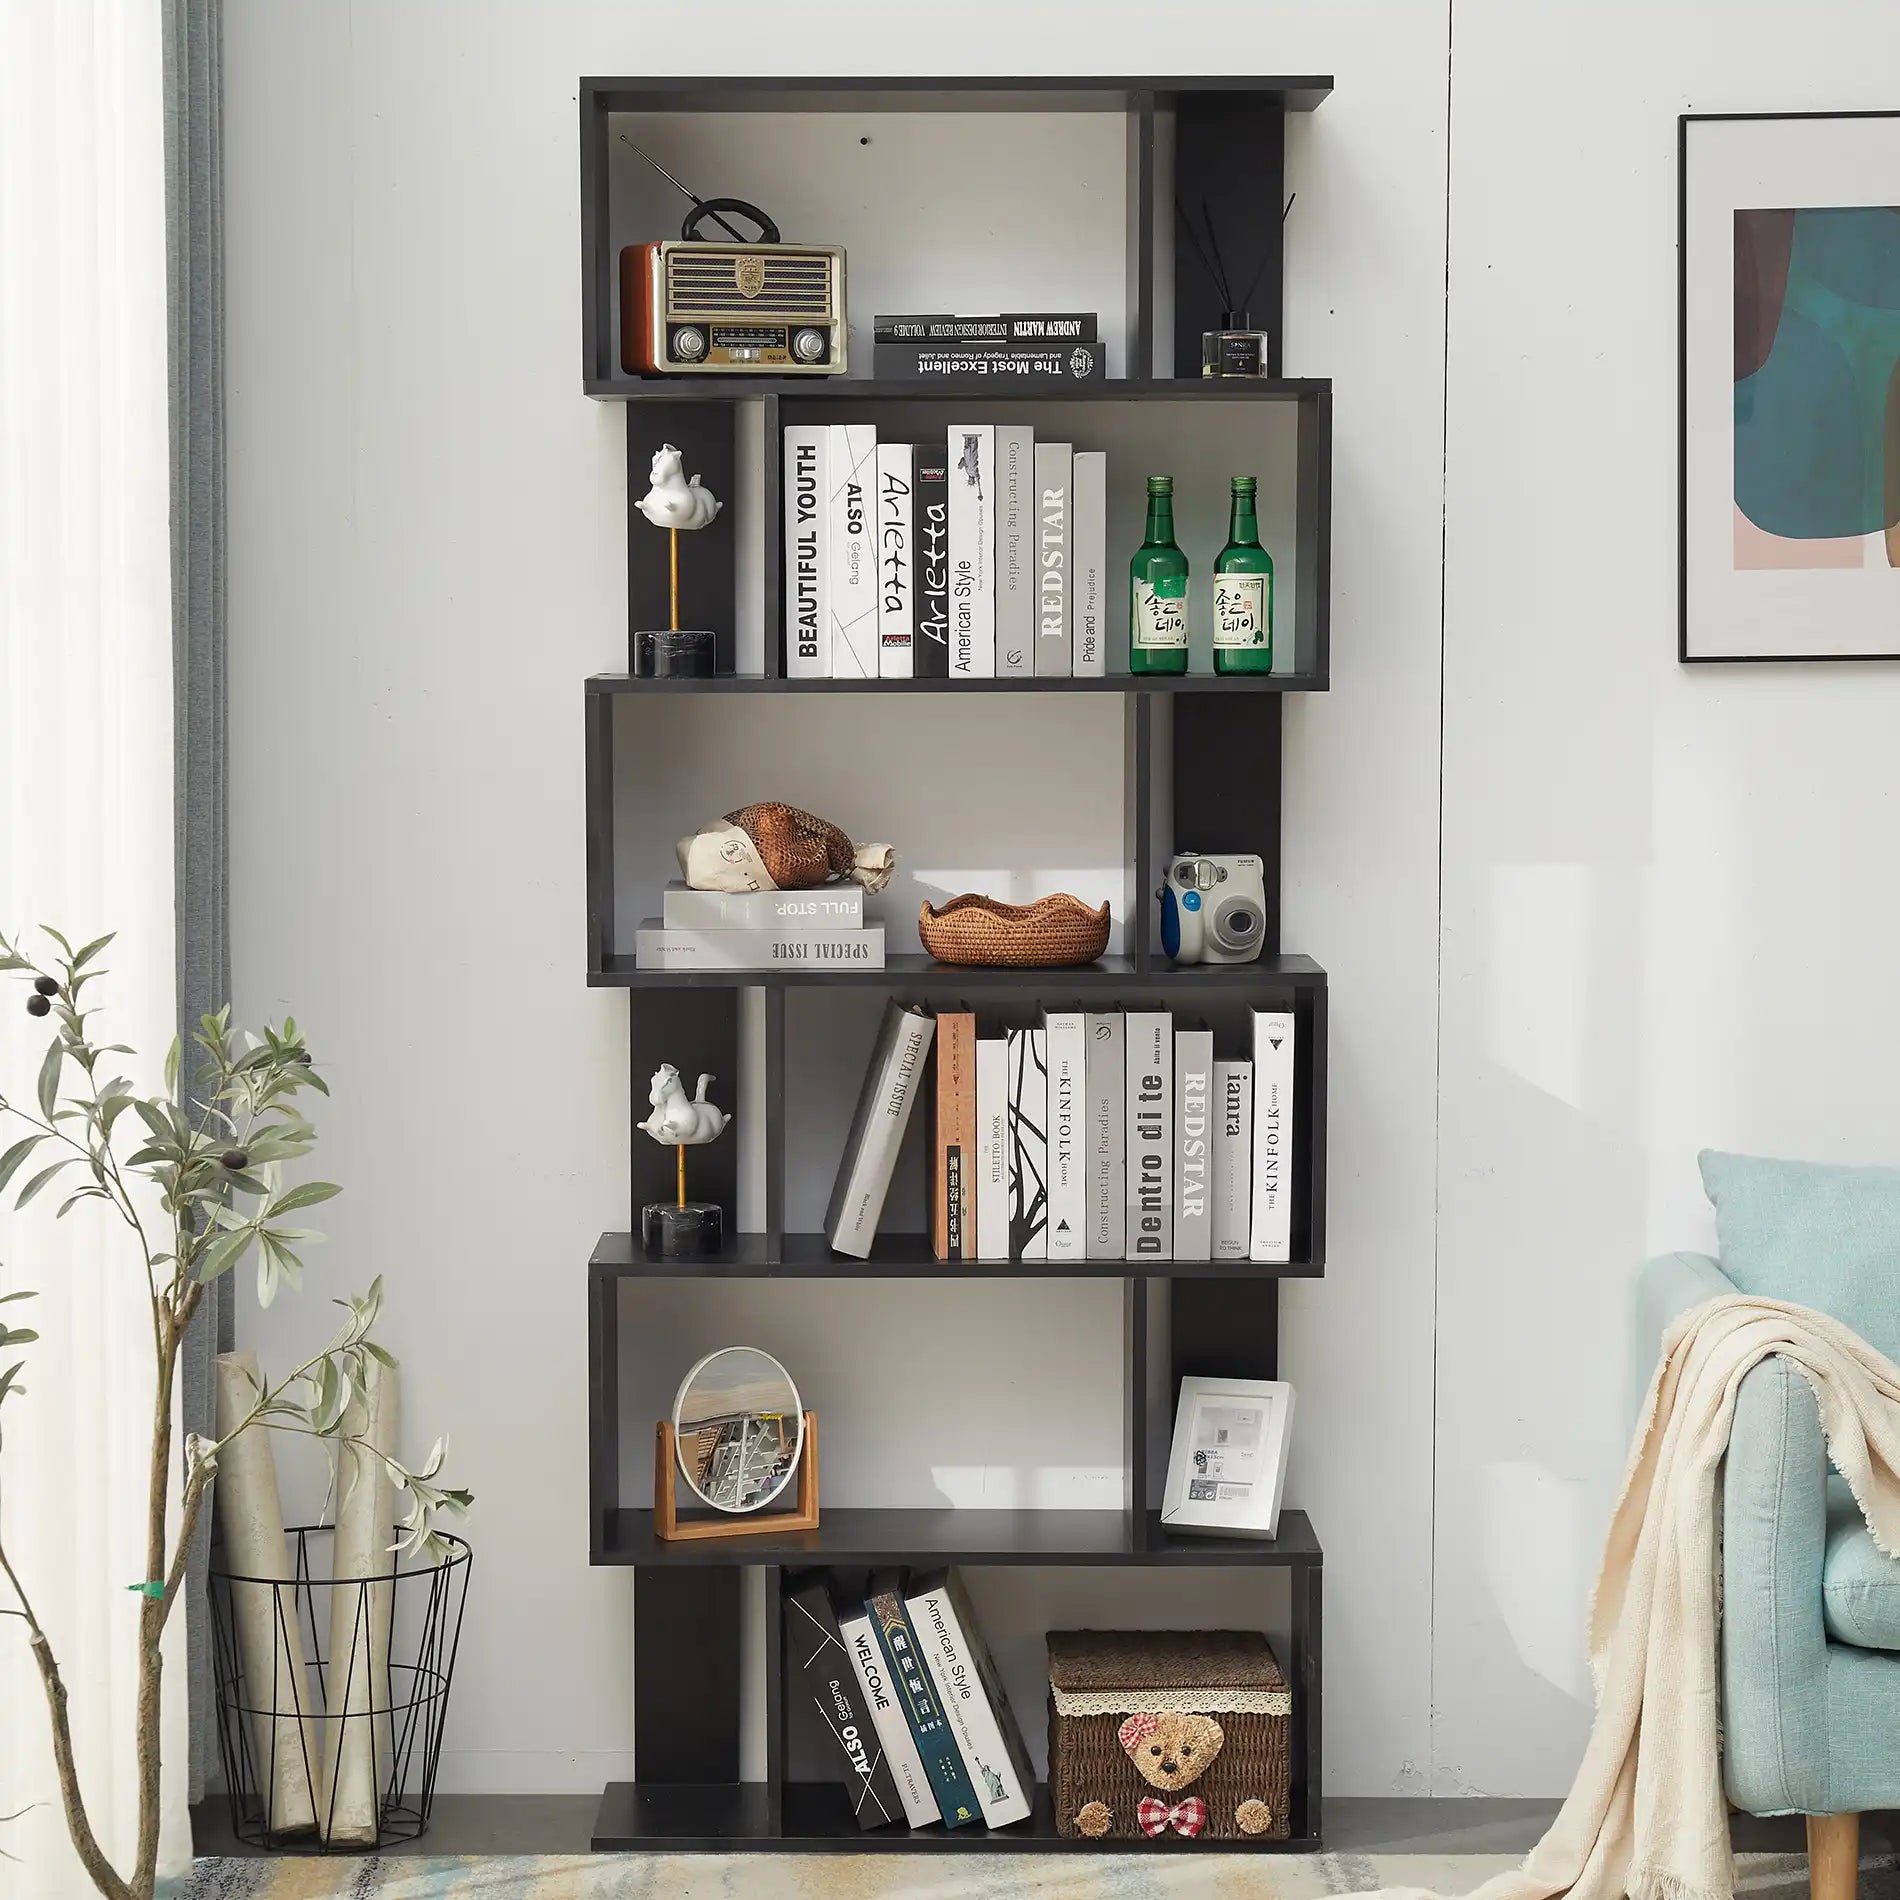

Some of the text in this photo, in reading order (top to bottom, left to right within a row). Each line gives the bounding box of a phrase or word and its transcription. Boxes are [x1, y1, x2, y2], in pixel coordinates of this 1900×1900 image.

[898, 322, 926, 336] VOLUME
[929, 323, 1007, 336] INTERIOR DESIGN REVIEW
[982, 352, 1009, 360] Tragedy
[1013, 321, 1082, 337] ANDREW MARTIN
[918, 361, 989, 374] Excellent
[993, 361, 1030, 374] Most
[1034, 361, 1063, 374] The
[847, 483, 863, 535] ALSO
[882, 472, 910, 614] Arletta
[1008, 442, 1020, 591] Constructing Paradies
[796, 445, 818, 658] BEAUTIFUL YOUTH
[849, 541, 861, 586] Gelang
[920, 503, 947, 645] Arletta
[1042, 487, 1064, 639] REDSTAR
[954, 559, 975, 673] American Style
[1082, 568, 1097, 663] Pride and Prejudice
[1215, 588, 1246, 616] 좋은
[1222, 612, 1255, 632] 데이
[775, 902, 859, 915] FULL STOP.
[772, 943, 869, 959] SPECIAL ISSUE
[887, 1031, 923, 1117] SPECIAL ISSUE
[1226, 1074, 1248, 1137] ianra
[991, 1114, 1001, 1184] STILETTO BOOK
[1059, 1077, 1072, 1163] KINFOLK
[1183, 1071, 1206, 1219] REDSTAR
[1267, 1107, 1280, 1193] KINFOLK
[1098, 1098, 1109, 1244] Constructing Paradies
[1136, 1074, 1163, 1254] Dentro di te
[854, 1634, 890, 1711] WELCOME
[925, 1598, 971, 1700] American Style
[828, 1679, 849, 1721] Gelang
[932, 1652, 975, 1750] New York Interior Design Opuses
[842, 1725, 871, 1773] ALSO
